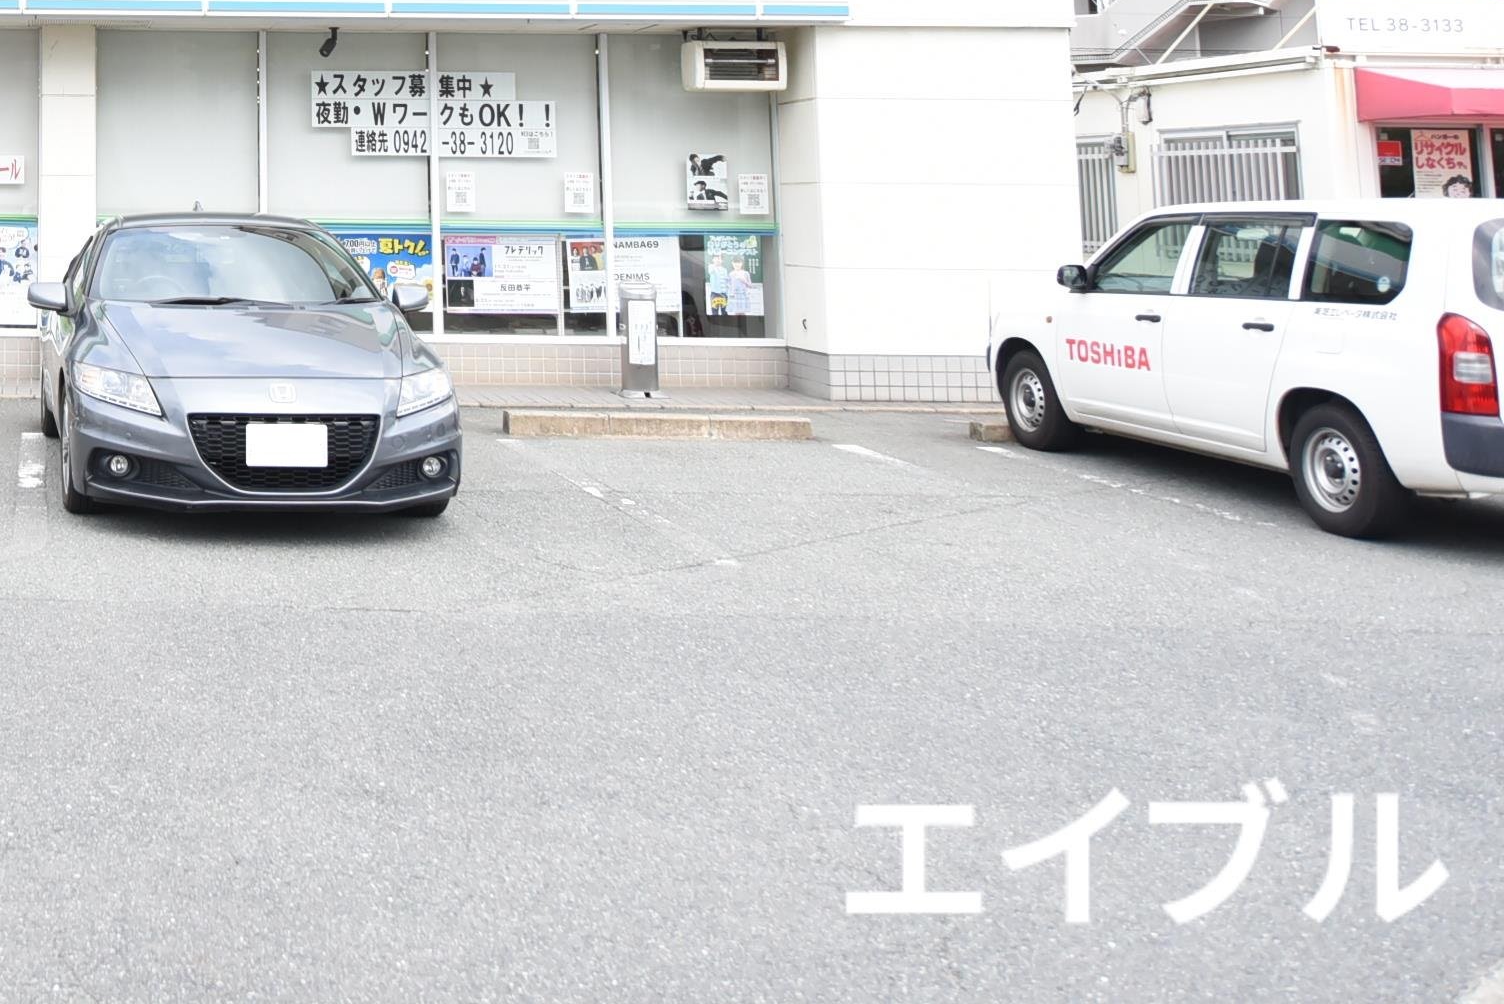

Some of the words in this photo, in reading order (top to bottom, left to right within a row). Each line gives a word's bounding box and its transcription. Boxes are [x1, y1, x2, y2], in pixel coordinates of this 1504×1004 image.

[1346, 17, 1381, 32] TEL
[1386, 17, 1464, 33] 38-3133
[355, 129, 389, 153] 連絡先
[392, 130, 514, 155] 0942-38-3120
[1414, 141, 1466, 156] リサイクル
[504, 245, 544, 256] フレデリック
[614, 273, 650, 281] DENIMS
